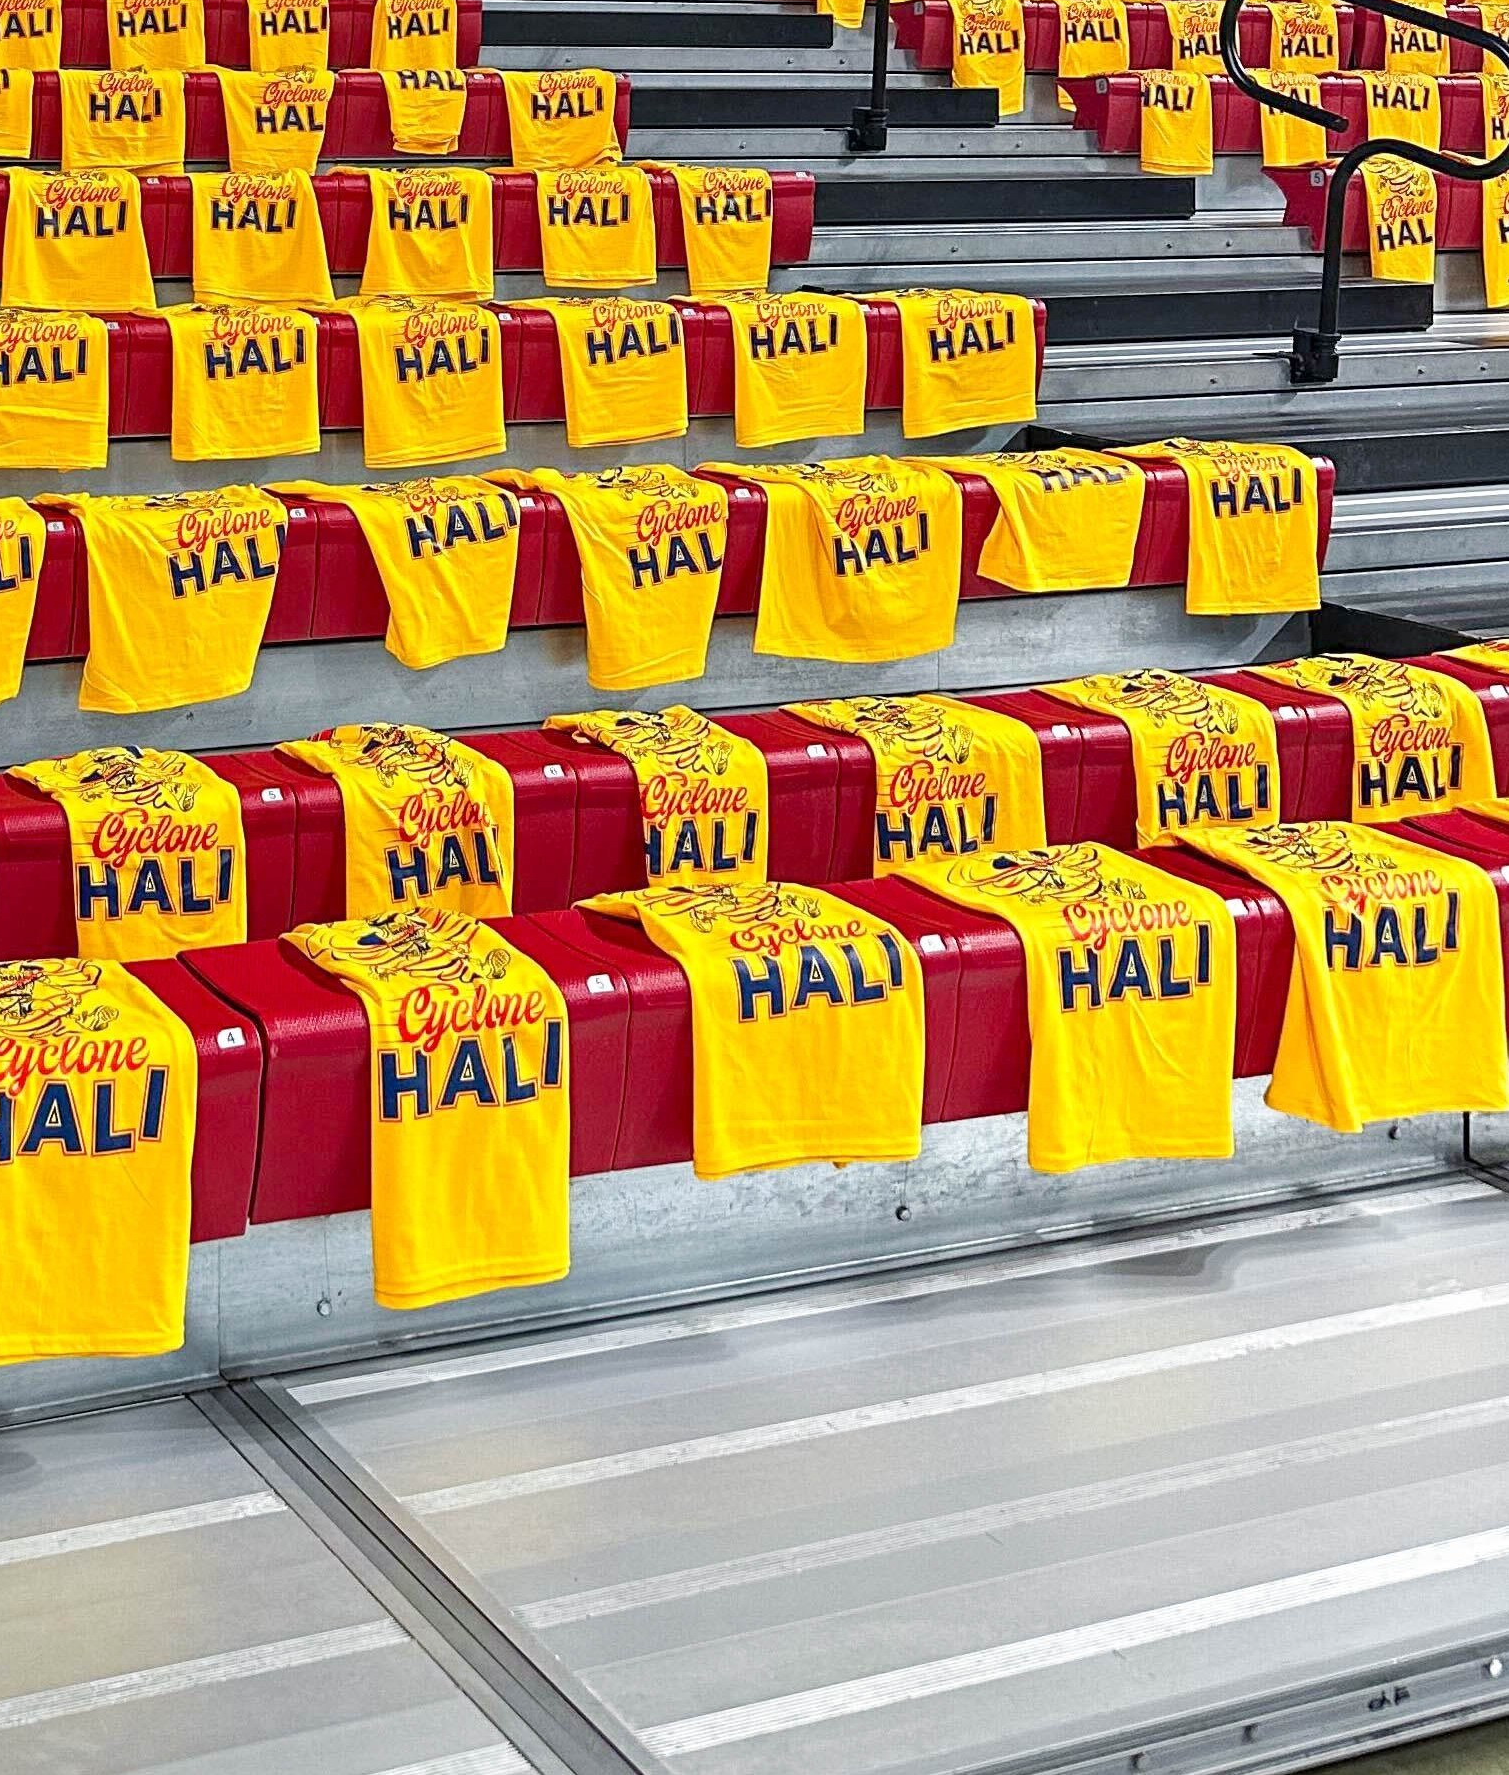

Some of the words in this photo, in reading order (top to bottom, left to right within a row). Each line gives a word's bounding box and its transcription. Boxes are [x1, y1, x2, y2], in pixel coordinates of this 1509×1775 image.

[260, 7, 327, 36] HALI
[961, 29, 1018, 57] HALI
[1065, 19, 1120, 44] HALI
[535, 85, 603, 118] HALI
[1372, 83, 1430, 111] HALI
[37, 202, 126, 237] HALI
[212, 201, 295, 232] HALI
[549, 196, 628, 226] HALI
[696, 192, 772, 222] HALI
[211, 310, 293, 342] Cyclone
[587, 317, 679, 364] HALI
[751, 316, 837, 358] HALI
[930, 313, 1014, 359] HALI
[206, 330, 304, 378] HALI
[396, 331, 488, 381] HALI
[1212, 469, 1301, 515] HALI
[175, 502, 270, 547] Cyclone
[407, 493, 518, 557] HALI
[635, 505, 719, 545] Cyclone
[836, 496, 916, 539] Cyclone
[835, 513, 928, 575] HALI
[1164, 732, 1252, 782] Cyclone
[1361, 746, 1461, 805] HALI
[638, 775, 746, 827] Cyclone
[888, 763, 986, 812] Cyclone
[1158, 765, 1268, 826] HALI
[89, 809, 216, 869] Cyclone
[876, 793, 999, 862] HALI
[78, 849, 232, 919] HALI
[733, 919, 867, 958] Cyclone
[1062, 902, 1195, 950] Cyclone
[1324, 893, 1458, 969] HALI
[734, 934, 903, 1019] HALI
[1060, 925, 1210, 1010] HALI
[395, 984, 542, 1053] Cyclone
[381, 1021, 561, 1119] HALI
